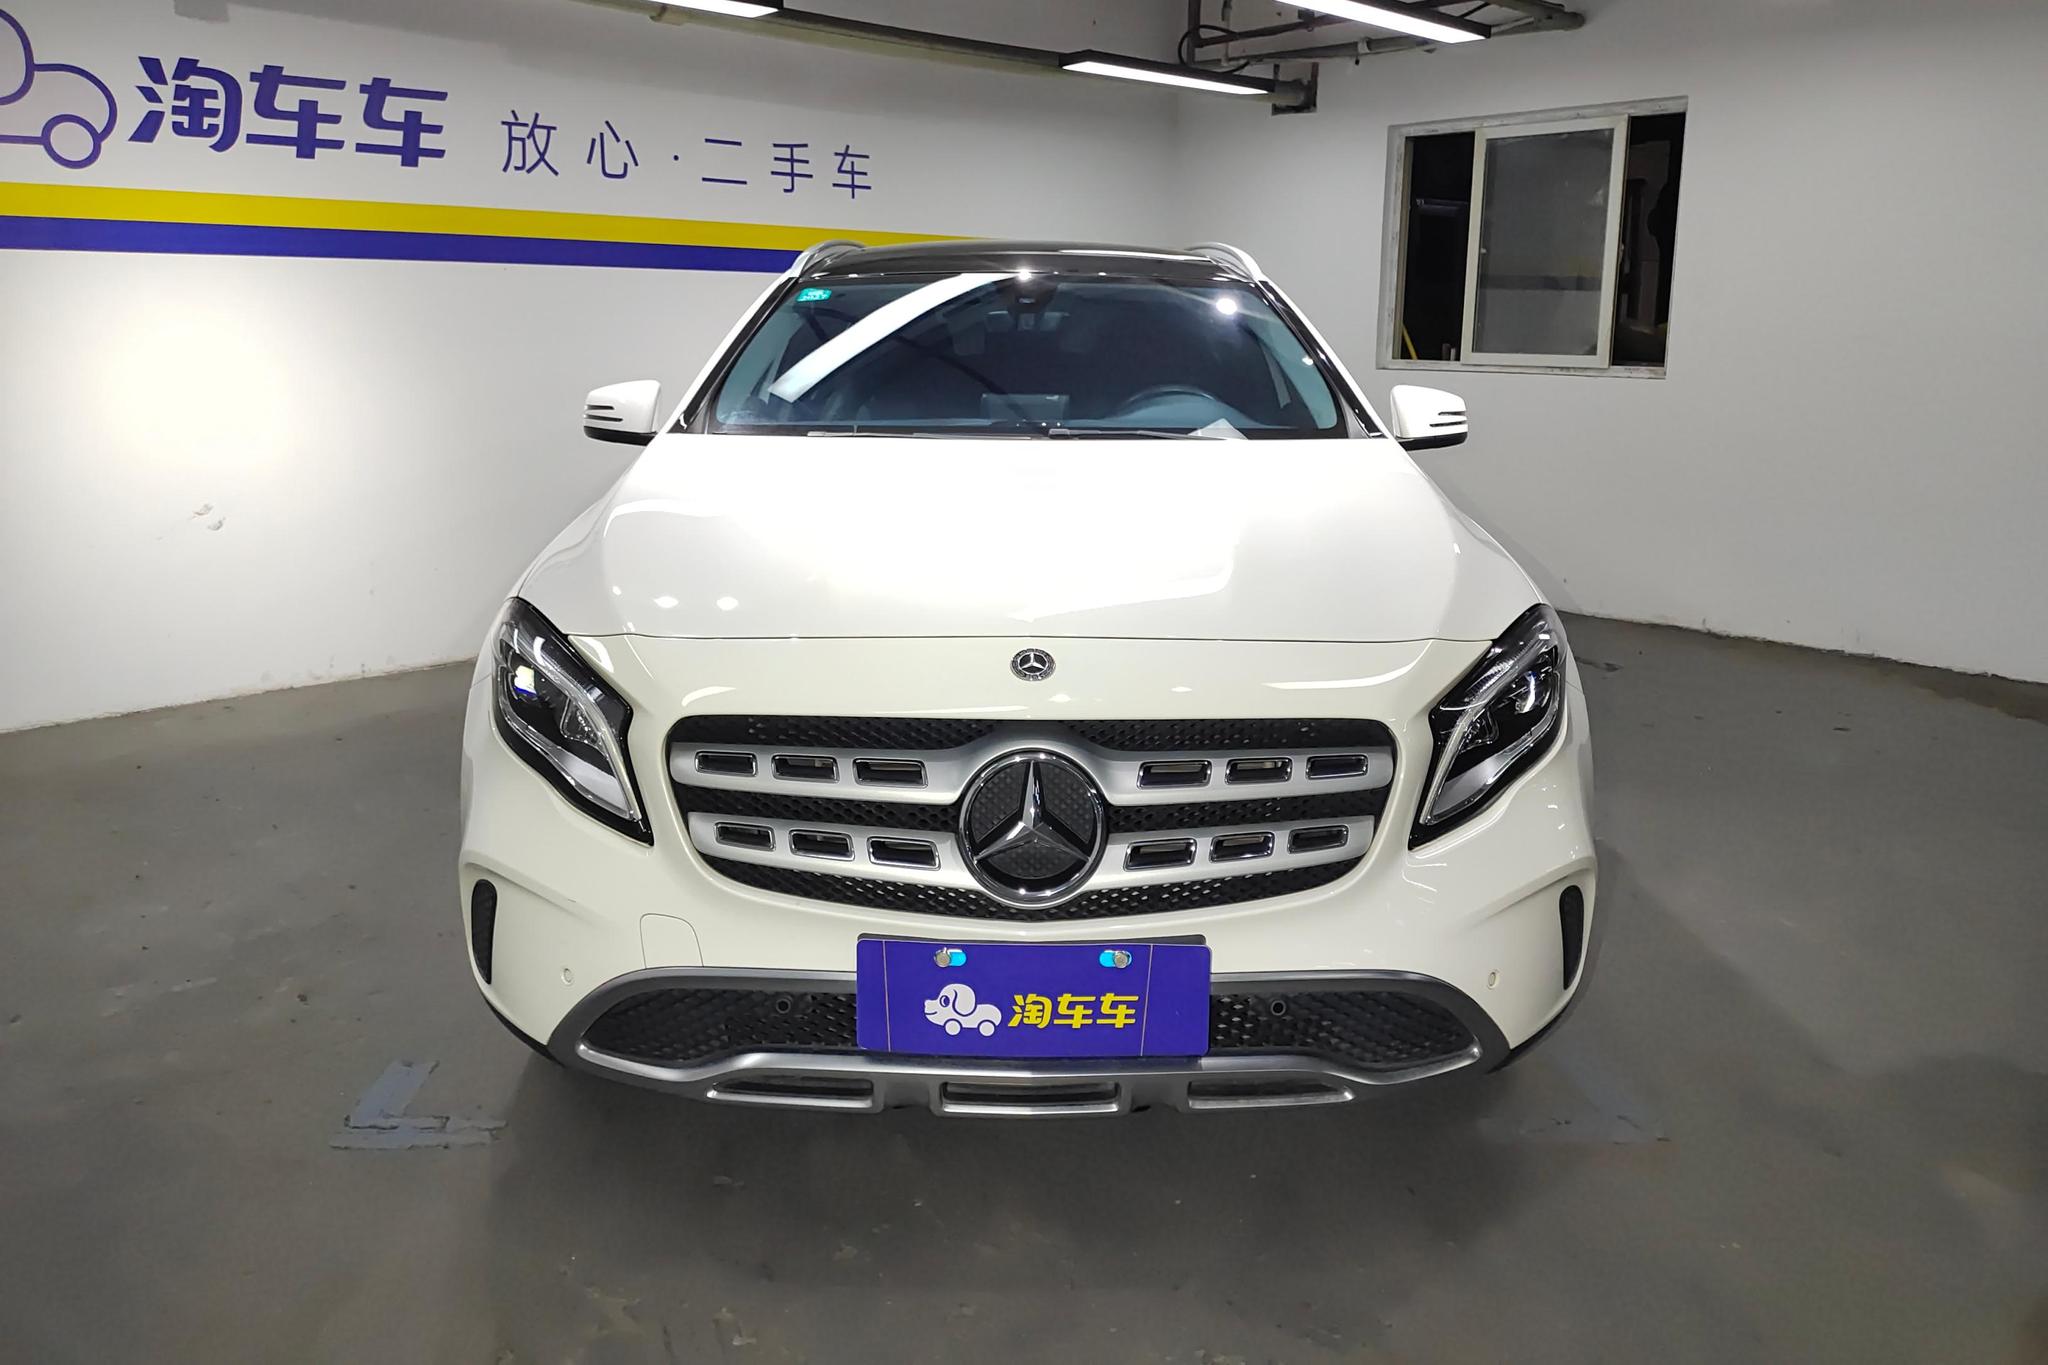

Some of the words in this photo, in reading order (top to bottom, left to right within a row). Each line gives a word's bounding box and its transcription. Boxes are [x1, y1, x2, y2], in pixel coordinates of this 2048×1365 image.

[128, 56, 448, 168] 淘车车
[1008, 992, 1139, 1029] 淘车车
